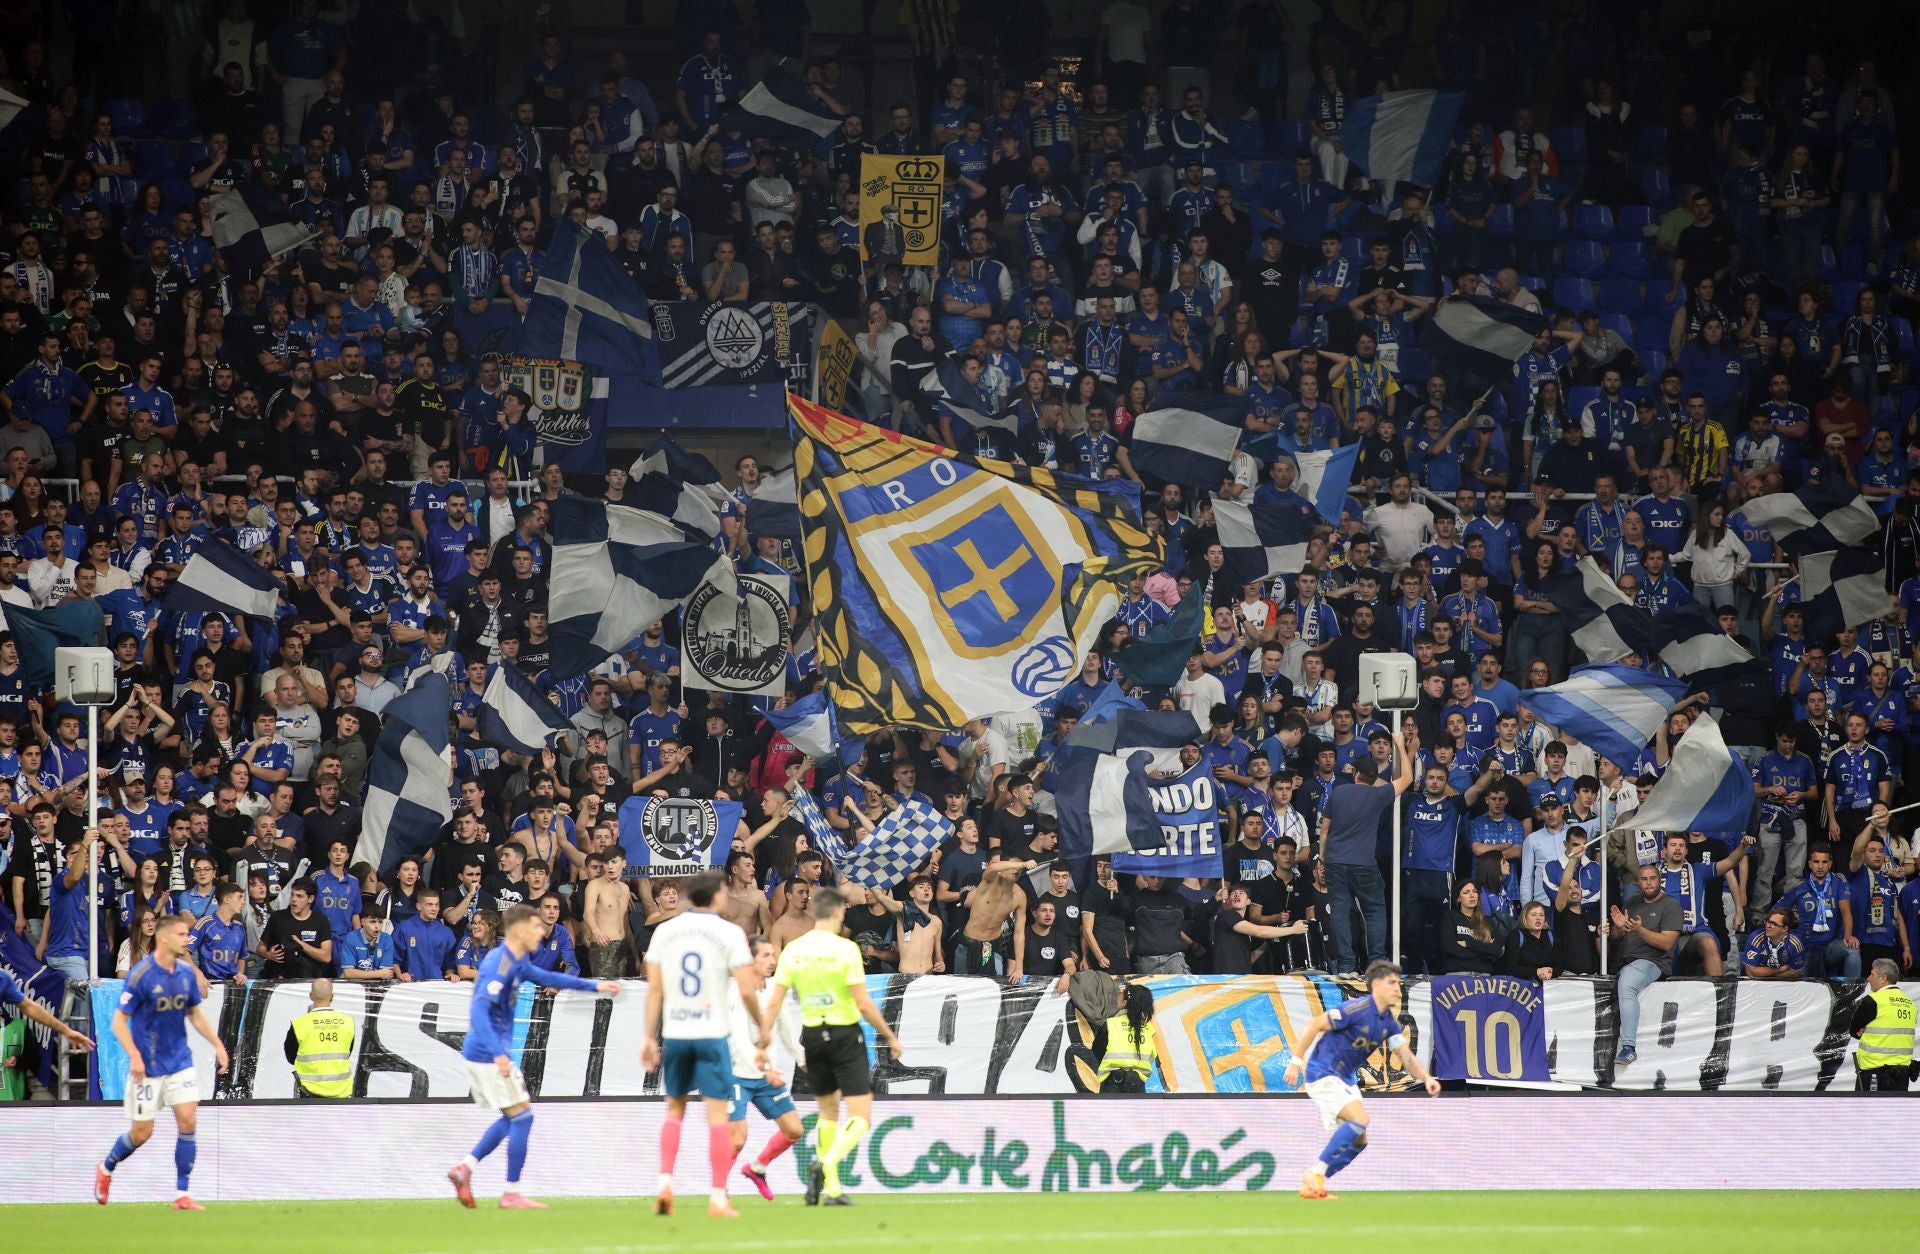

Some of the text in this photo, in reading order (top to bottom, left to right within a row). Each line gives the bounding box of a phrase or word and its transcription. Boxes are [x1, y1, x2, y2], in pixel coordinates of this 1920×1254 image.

[700, 301, 722, 326] OVIEDO
[882, 457, 957, 511] R O
[1651, 520, 1684, 528] DIGI
[700, 650, 774, 683] Oviedo
[0, 694, 23, 703] IGI
[1772, 776, 1802, 788] DIGI
[1148, 776, 1214, 815] NDO
[1413, 812, 1443, 822] DIGI
[645, 833, 664, 854] FANS
[696, 799, 716, 836] ALISATION
[622, 864, 705, 877] SANCIONADOS
[321, 895, 351, 910] DIG
[212, 949, 240, 963] DII
[680, 951, 702, 998] 8
[1436, 978, 1542, 1013] VILLAVERDE
[1897, 1009, 1911, 1020] 051
[319, 1032, 338, 1042] 048
[1128, 1033, 1146, 1045] 00
[1455, 1009, 1523, 1080] 10
[136, 1083, 154, 1101] 20
[869, 1115, 1029, 1188] Corte
[1041, 1100, 1277, 1191] Inglés
